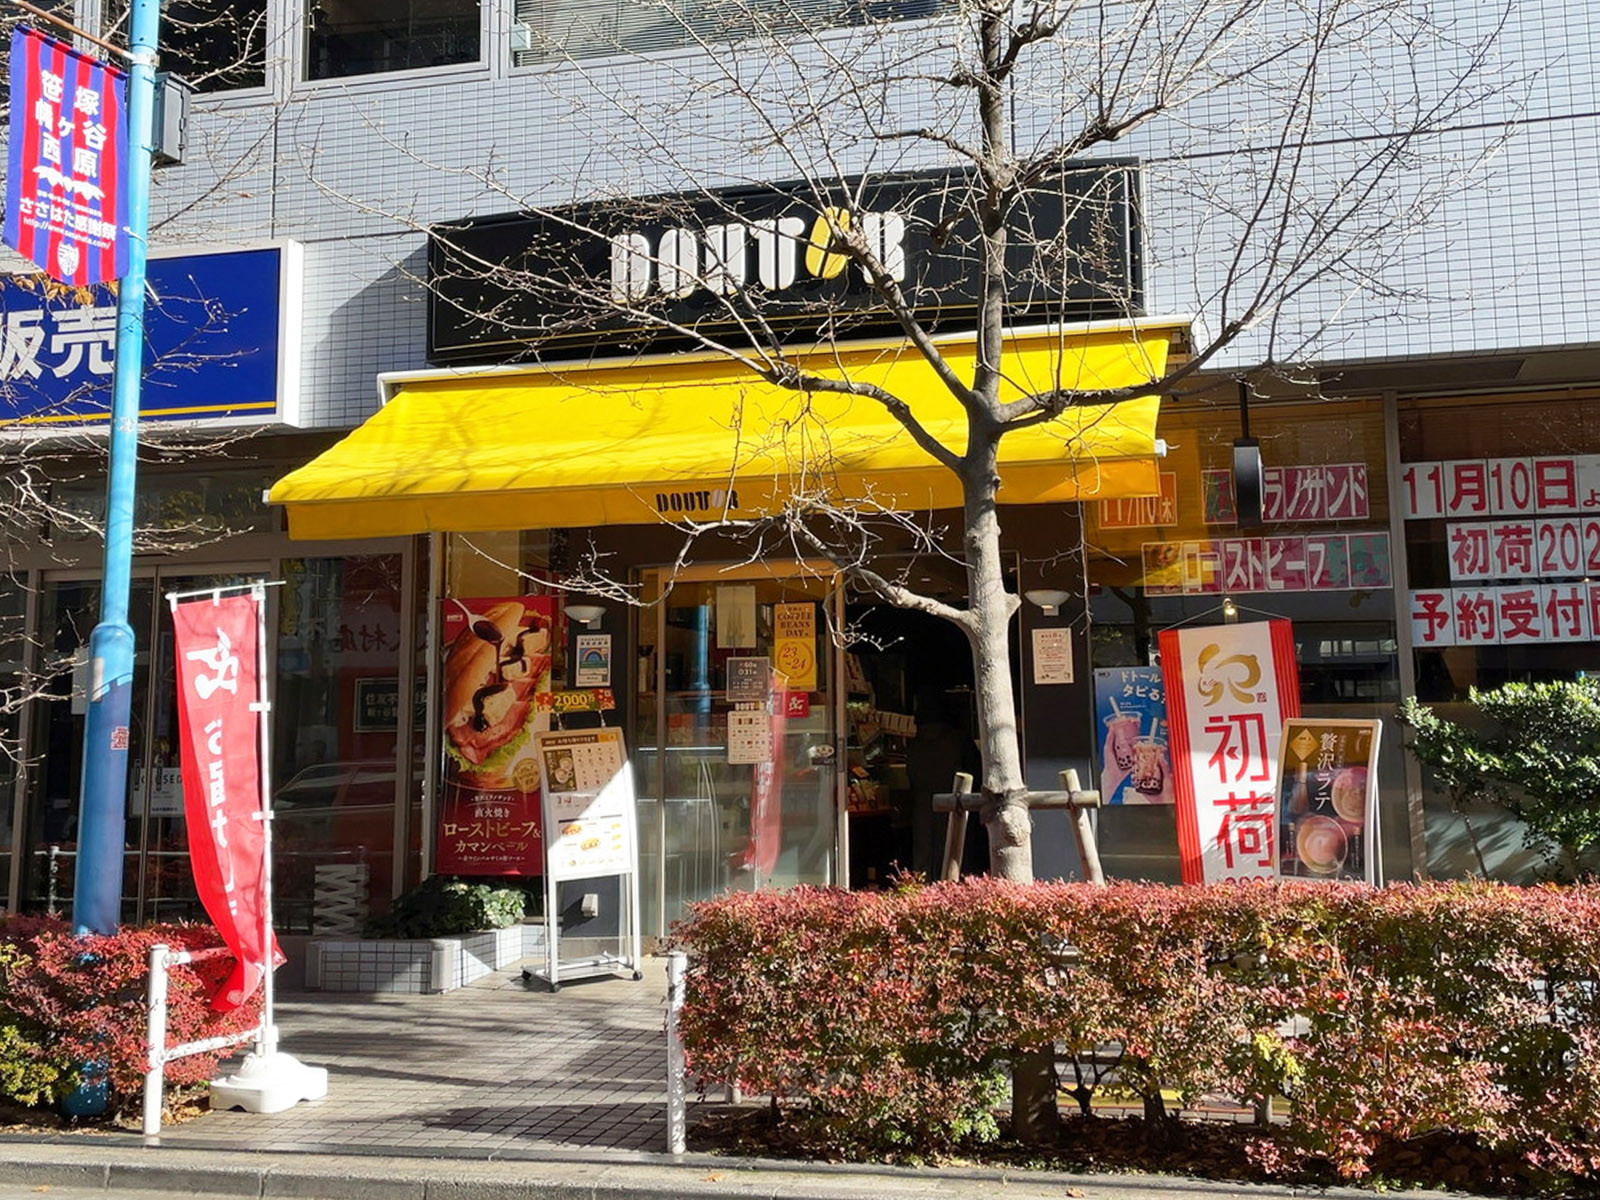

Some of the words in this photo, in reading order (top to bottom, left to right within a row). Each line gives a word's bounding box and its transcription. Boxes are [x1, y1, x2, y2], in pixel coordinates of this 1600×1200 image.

[611, 205, 906, 303] DOUTOR
[454, 840, 528, 853] カマンベール
